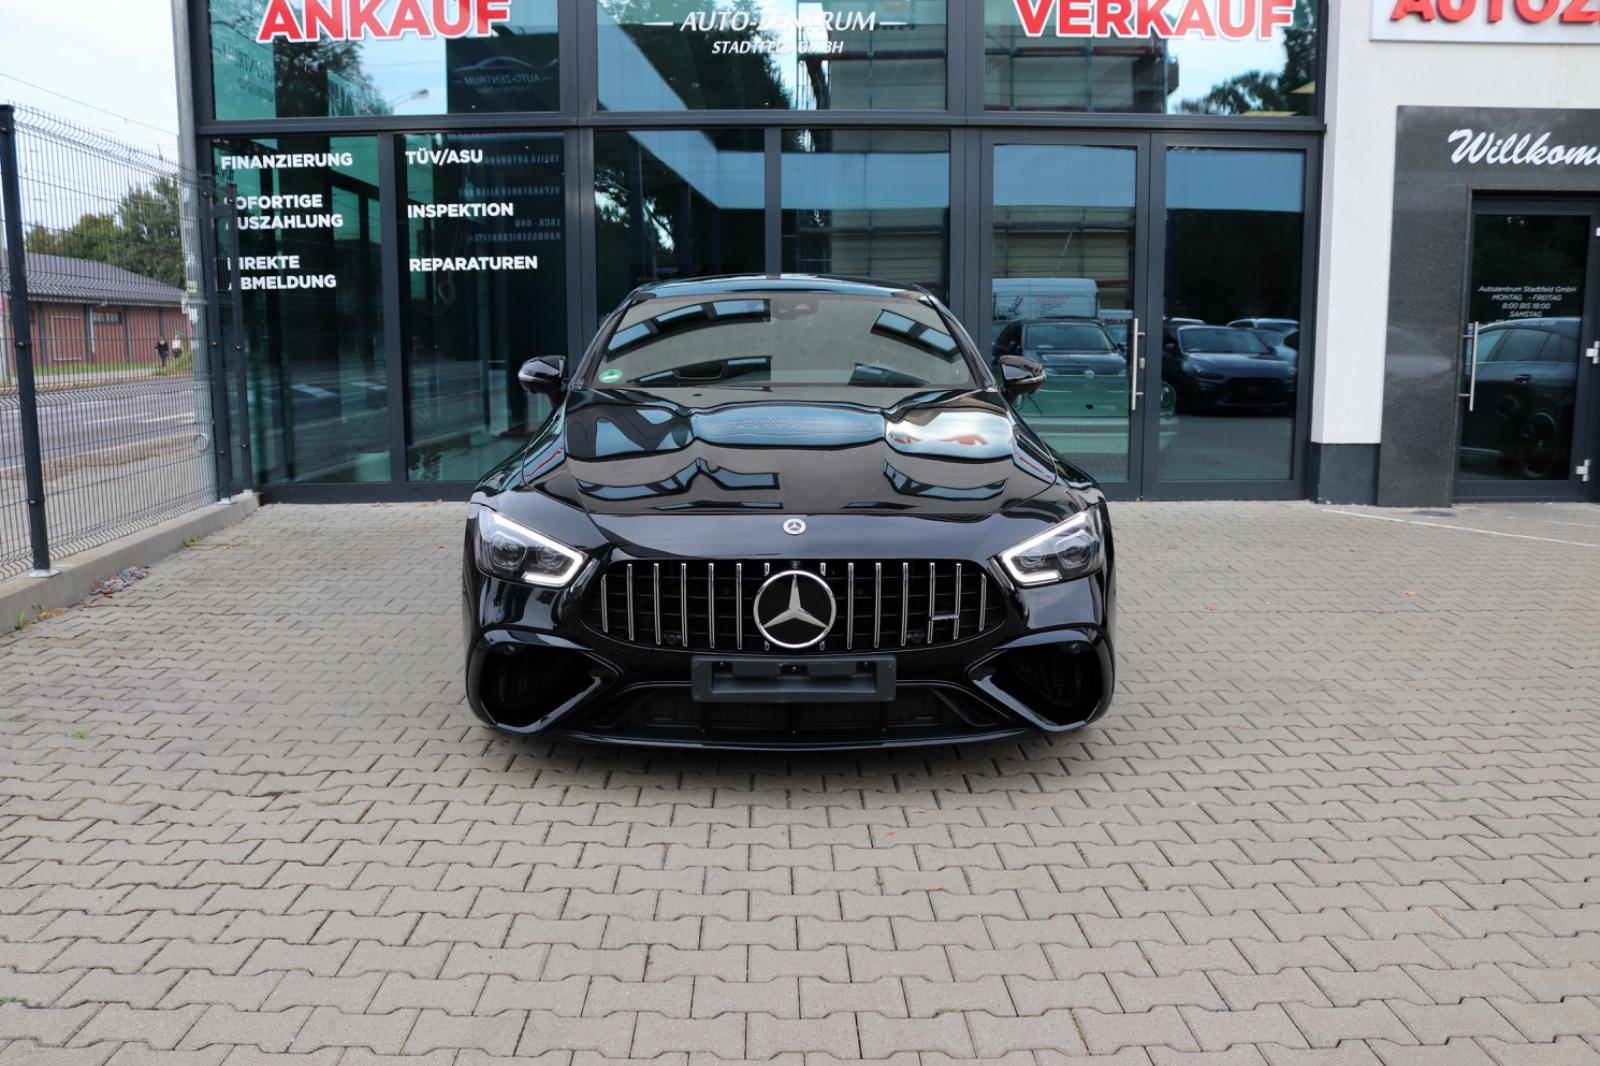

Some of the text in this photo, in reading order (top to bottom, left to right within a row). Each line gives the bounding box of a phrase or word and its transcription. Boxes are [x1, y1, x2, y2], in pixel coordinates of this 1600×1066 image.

[257, 0, 510, 42] ANKAUF
[1015, 0, 1296, 41] VERKAUF
[1448, 129, 1600, 166] Willkom
[220, 152, 353, 170] FINANZIERUNG
[405, 148, 483, 166] TÜV/ASU
[407, 202, 514, 219] INSPEKTION
[225, 214, 344, 230] USZAHLUNG
[409, 256, 538, 272] REPARATUREN
[228, 274, 337, 290] BMELDUNG
[1509, 310, 1543, 318] SAMSTAG
